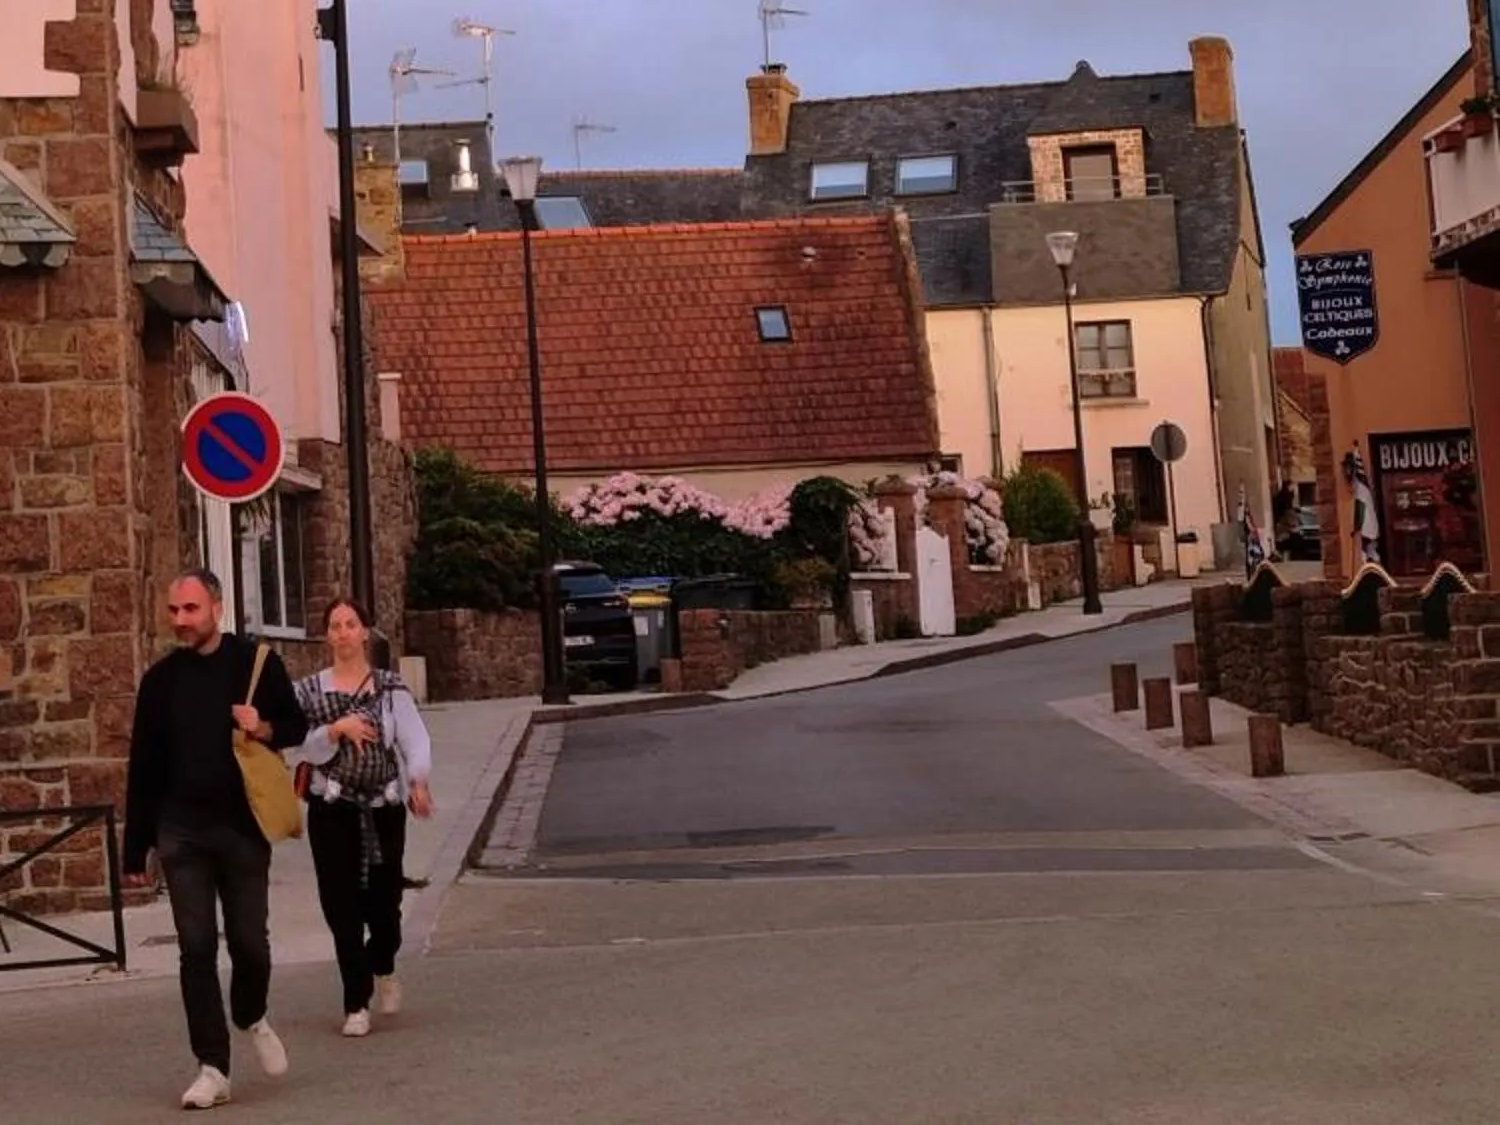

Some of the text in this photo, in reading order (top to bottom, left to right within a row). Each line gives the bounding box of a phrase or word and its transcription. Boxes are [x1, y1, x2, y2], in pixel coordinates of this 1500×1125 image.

[1311, 296, 1363, 310] BIJOUX
[1304, 308, 1373, 323] CELTIQUES
[1380, 442, 1449, 469] BIJOUX
